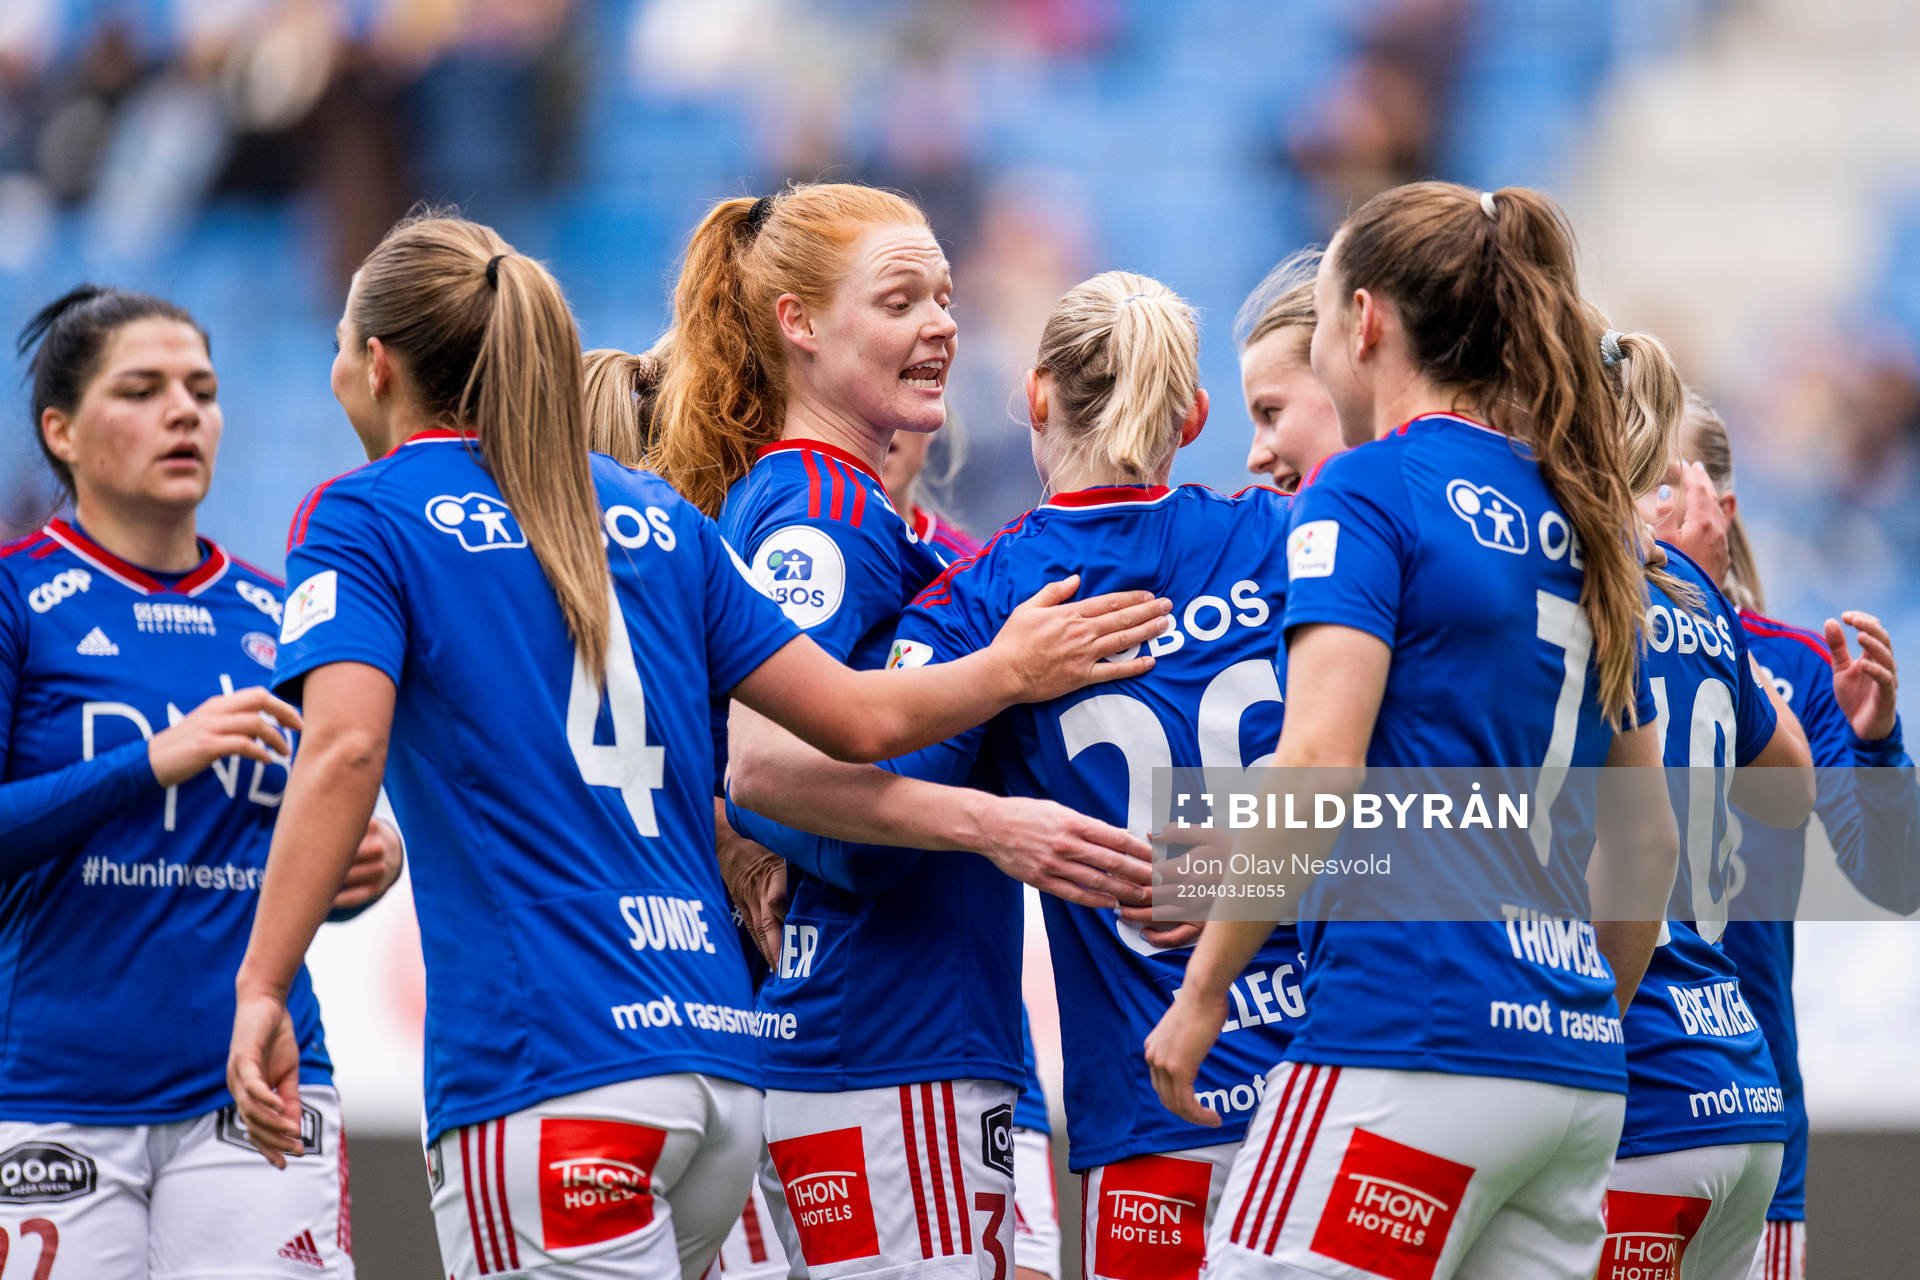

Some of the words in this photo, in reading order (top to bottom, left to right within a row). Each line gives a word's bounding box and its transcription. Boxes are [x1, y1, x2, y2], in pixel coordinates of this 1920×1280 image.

[601, 504, 677, 552] OS
[151, 603, 213, 625] STENA
[768, 587, 824, 608] BOS
[1104, 579, 1270, 663] BOS
[1646, 604, 1736, 661] OBOS
[566, 575, 665, 838] 4
[1529, 589, 1593, 867] 7
[1649, 677, 1737, 946] 10
[619, 895, 716, 954] SUNDE
[777, 924, 819, 979] ER
[611, 994, 683, 1030] mot
[1490, 1000, 1553, 1035] mot
[1560, 1009, 1625, 1045] rasism
[1196, 1074, 1266, 1113] mot
[1689, 1081, 1744, 1118] mot
[1, 1158, 83, 1188] ooni
[549, 1157, 646, 1188] THON
[787, 1170, 857, 1208] THON
[800, 1204, 853, 1228] HOTELS
[1107, 1190, 1196, 1225] THON
[1348, 1173, 1449, 1227] THON
[1111, 1223, 1183, 1246] HOTELS
[1347, 1206, 1427, 1247] HOTELS
[1606, 1231, 1686, 1264] THON
